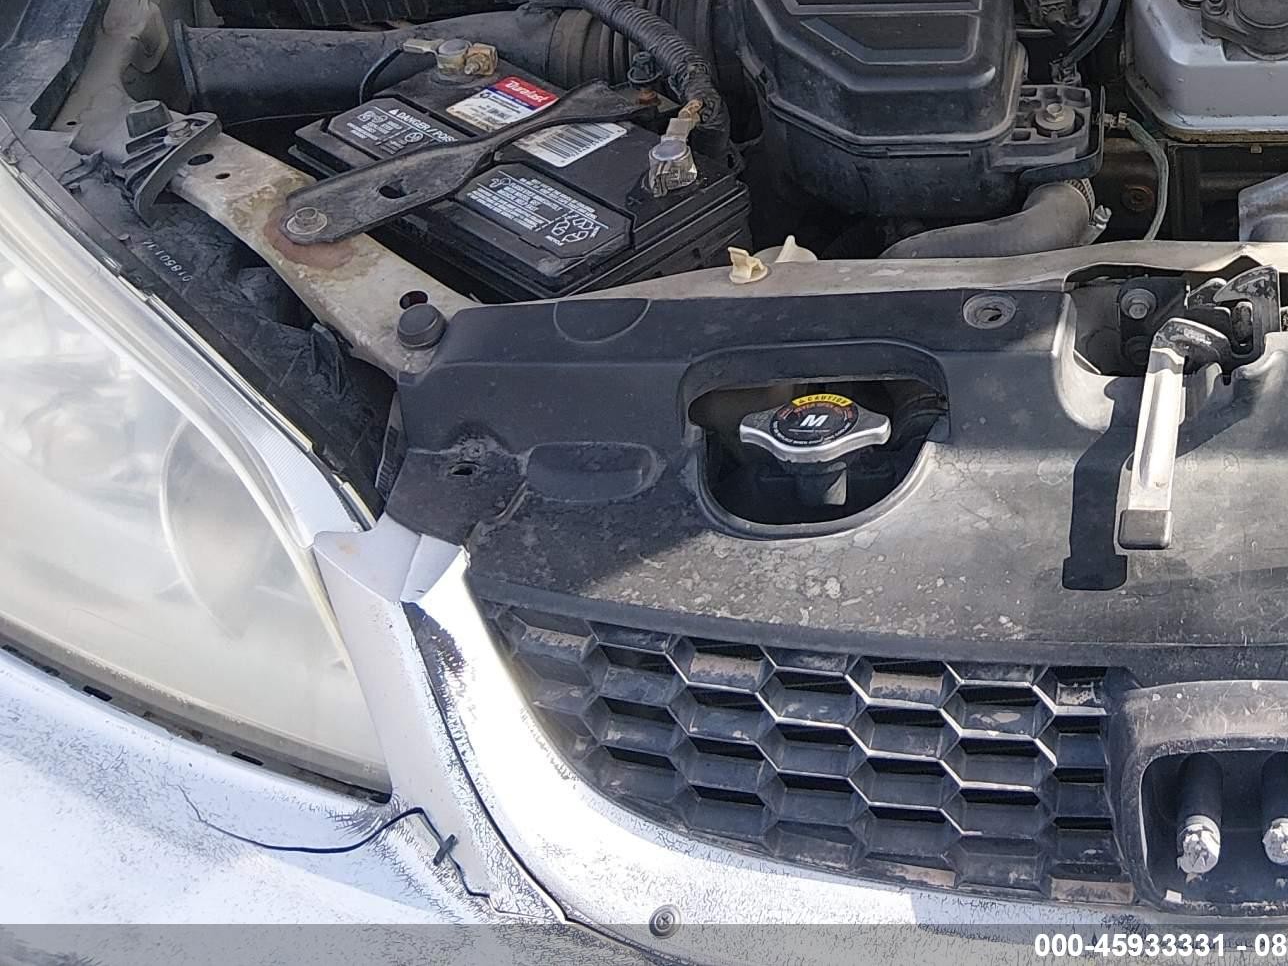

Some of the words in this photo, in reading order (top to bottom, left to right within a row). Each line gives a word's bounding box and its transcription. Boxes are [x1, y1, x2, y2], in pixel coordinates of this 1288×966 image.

[504, 79, 550, 104] Duralast
[397, 112, 431, 130] DANGER
[807, 395, 848, 405] CAUTION
[800, 414, 829, 426] M
